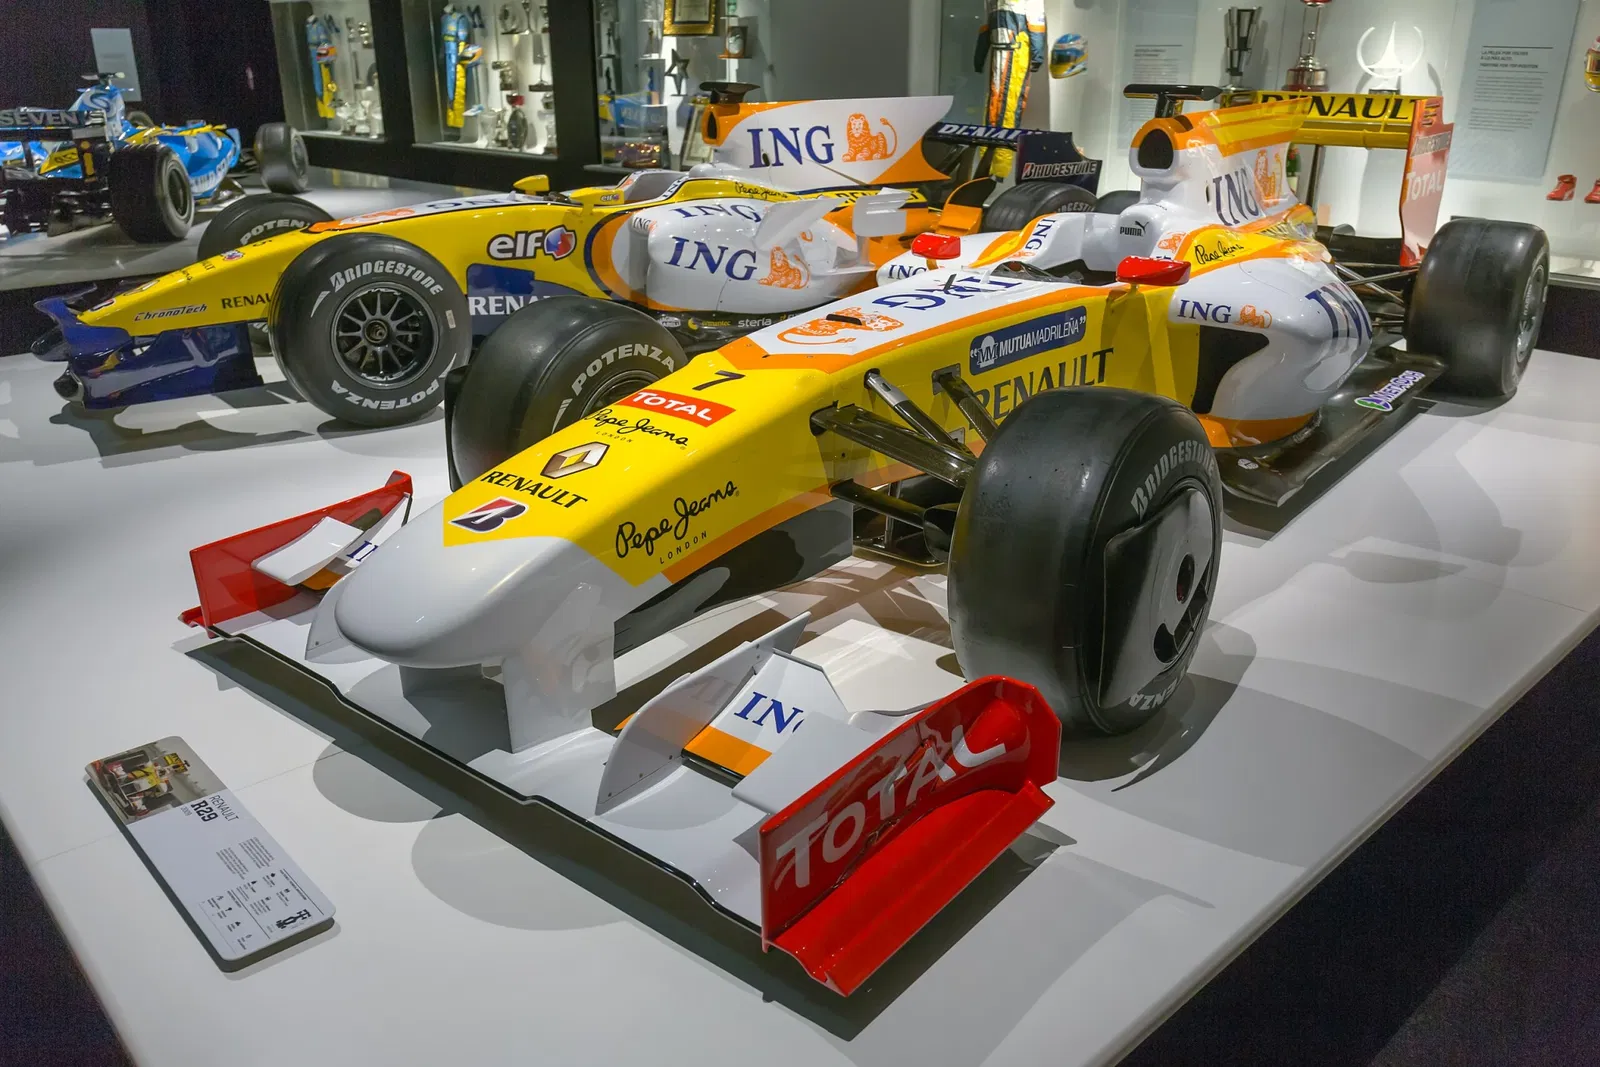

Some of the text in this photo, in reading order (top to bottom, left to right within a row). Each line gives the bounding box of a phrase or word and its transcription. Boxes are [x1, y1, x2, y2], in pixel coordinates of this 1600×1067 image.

[0, 111, 79, 127] SEVEN
[747, 125, 835, 168] ING
[1021, 161, 1098, 180] BRIDGESTONE
[1406, 170, 1443, 201] TOTAL
[633, 217, 651, 230] ING
[668, 203, 763, 223] ING
[489, 231, 543, 260] elf
[1025, 218, 1057, 251] ING
[1119, 226, 1143, 237] PUMA
[664, 236, 758, 281] ING
[329, 259, 444, 293] BRIDGESTONE
[737, 317, 772, 329] steria
[1177, 299, 1232, 324] ING
[572, 343, 675, 396] POTENZA
[692, 370, 746, 391] 7
[331, 379, 440, 410] POTENZA
[632, 391, 714, 421] TOTAL
[584, 409, 689, 446] Pepe Jeans
[596, 431, 632, 443] LONDON
[481, 470, 588, 508] RENAULT
[1130, 440, 1214, 520] BRIDGESTONE
[615, 480, 738, 559] Pepe Jeans
[659, 530, 707, 565] LONDON
[734, 691, 804, 734] IN
[190, 799, 219, 823] R29
[209, 794, 240, 822] RENAULT
[774, 723, 1007, 892] TOTAL
